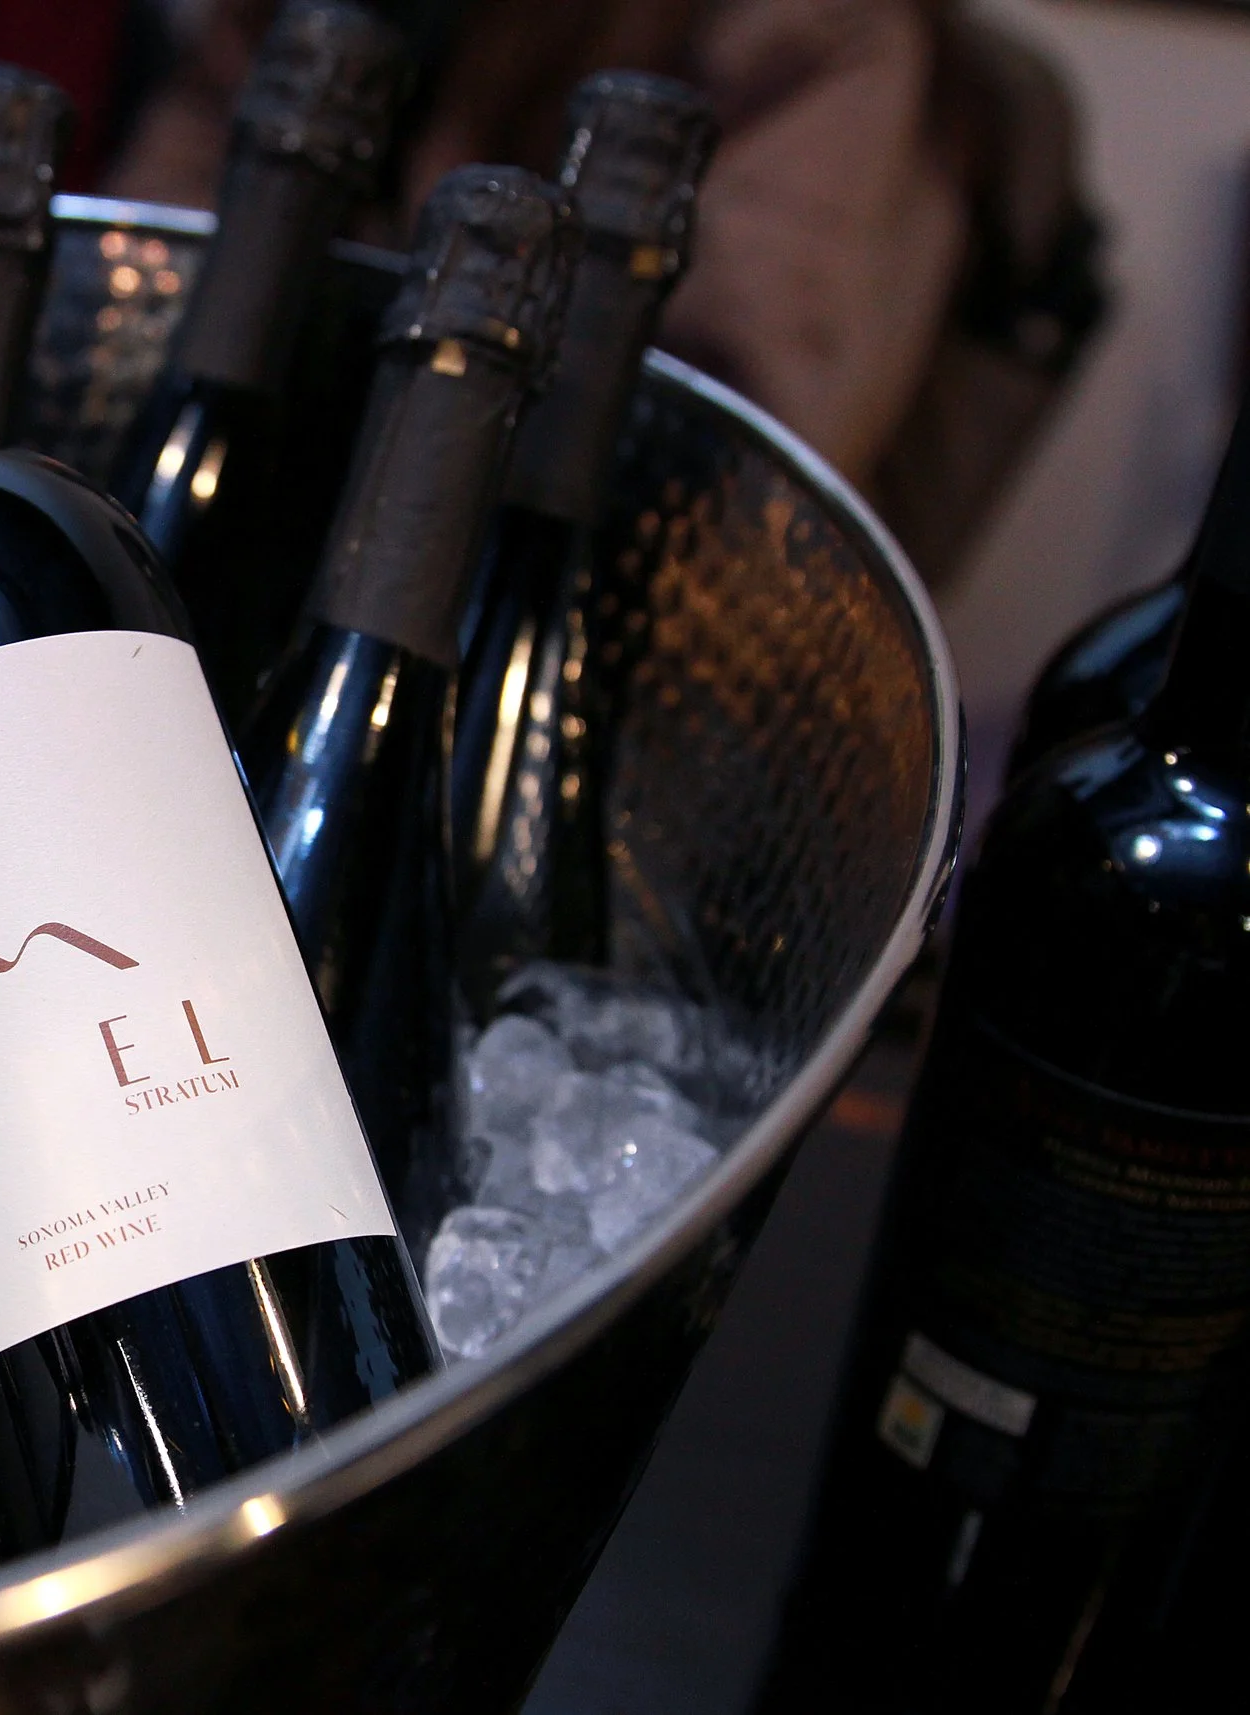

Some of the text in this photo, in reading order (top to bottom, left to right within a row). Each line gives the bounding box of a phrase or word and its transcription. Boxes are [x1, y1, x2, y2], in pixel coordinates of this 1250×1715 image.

[125, 1069, 240, 1116] STRATUM
[18, 1181, 169, 1250] SONOMA VALLEY
[44, 1214, 162, 1271] RED WINE
